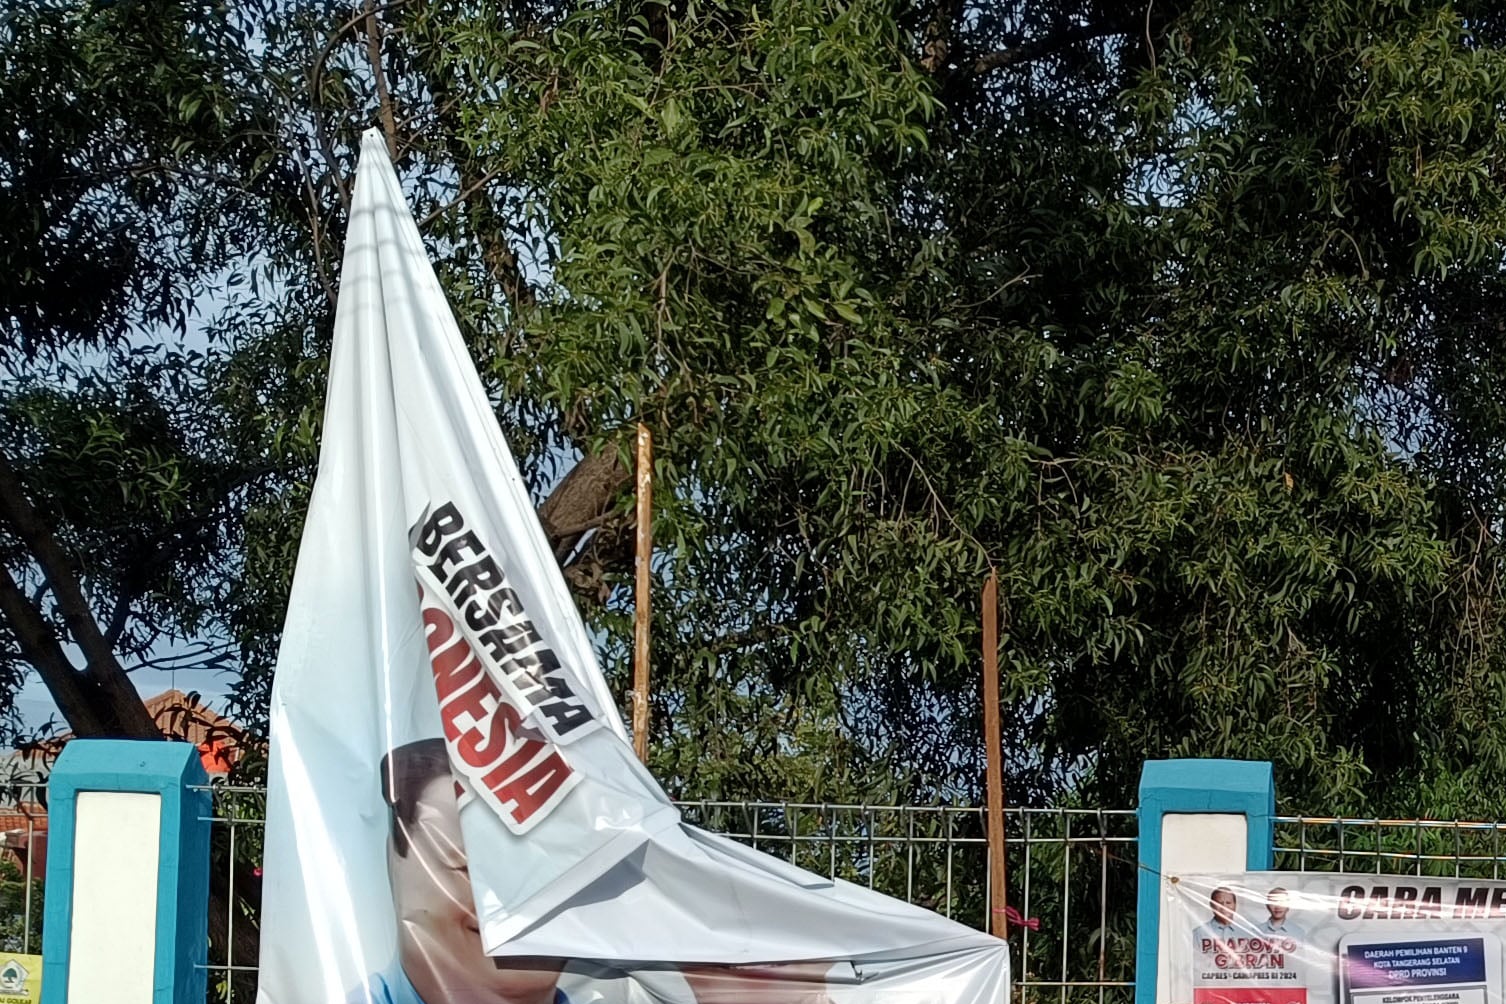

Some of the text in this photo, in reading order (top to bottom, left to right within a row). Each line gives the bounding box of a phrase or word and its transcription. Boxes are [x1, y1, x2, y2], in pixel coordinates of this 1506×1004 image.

[1337, 885, 1442, 920] CARA
[1365, 950, 1394, 959] DAERAH
[1396, 948, 1432, 956] PEMILIHAN
[1215, 954, 1284, 969] GBRAN
[1392, 958, 1430, 967] TANGERANG
[1432, 957, 1460, 965] SELATAN
[1412, 968, 1446, 977] PROVINSI
